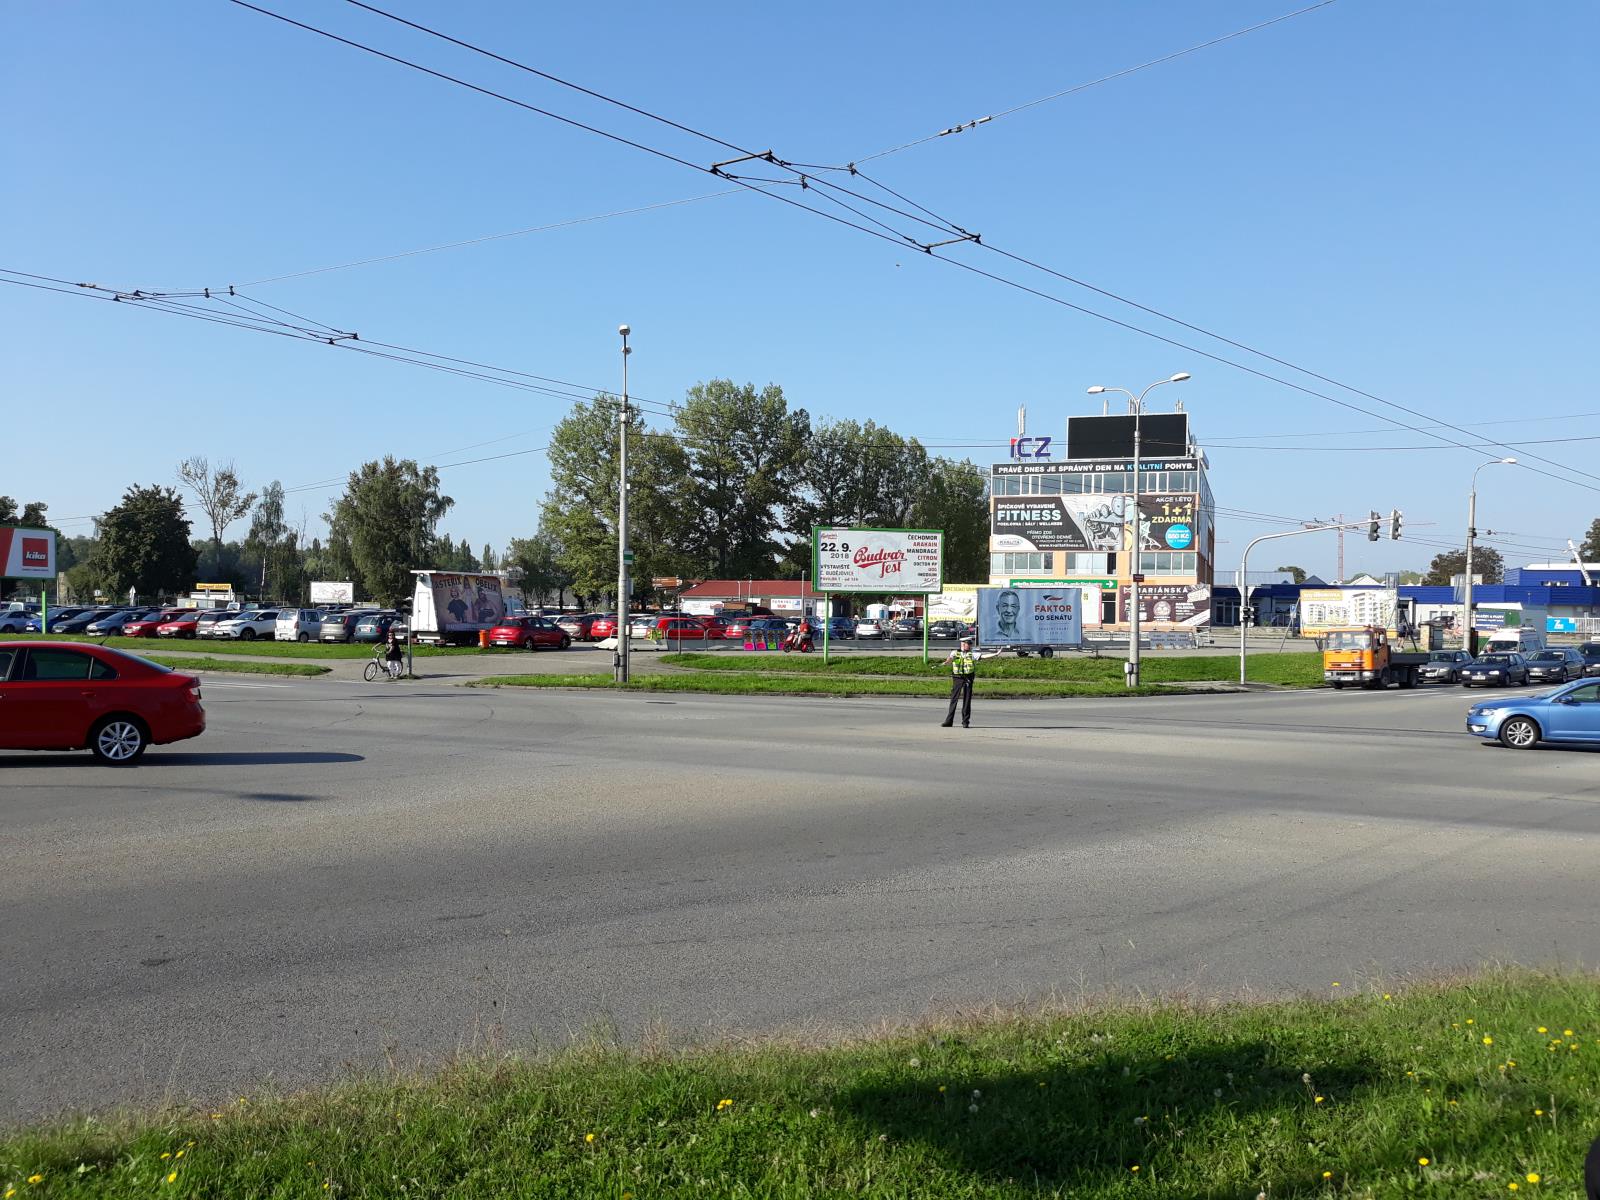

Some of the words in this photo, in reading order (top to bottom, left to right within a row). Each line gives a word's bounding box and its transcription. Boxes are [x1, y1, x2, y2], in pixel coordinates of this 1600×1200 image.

[998, 465, 1022, 474] PRÁVĚ
[1024, 465, 1045, 473] DNES
[1046, 465, 1056, 473] JE
[1058, 463, 1093, 472] SPRÁVNÝ
[1127, 462, 1163, 470] KALITNÍ
[1164, 462, 1195, 470] POHYB.
[997, 509, 1062, 521] FITNESS
[26, 551, 46, 560] kika
[853, 546, 907, 565] Budvar
[879, 561, 902, 579] fest
[435, 576, 462, 589] ASTERIX
[475, 577, 497, 591] OBELIX
[1034, 604, 1072, 612] FAKTOR
[1046, 613, 1072, 621] SENÁTU
